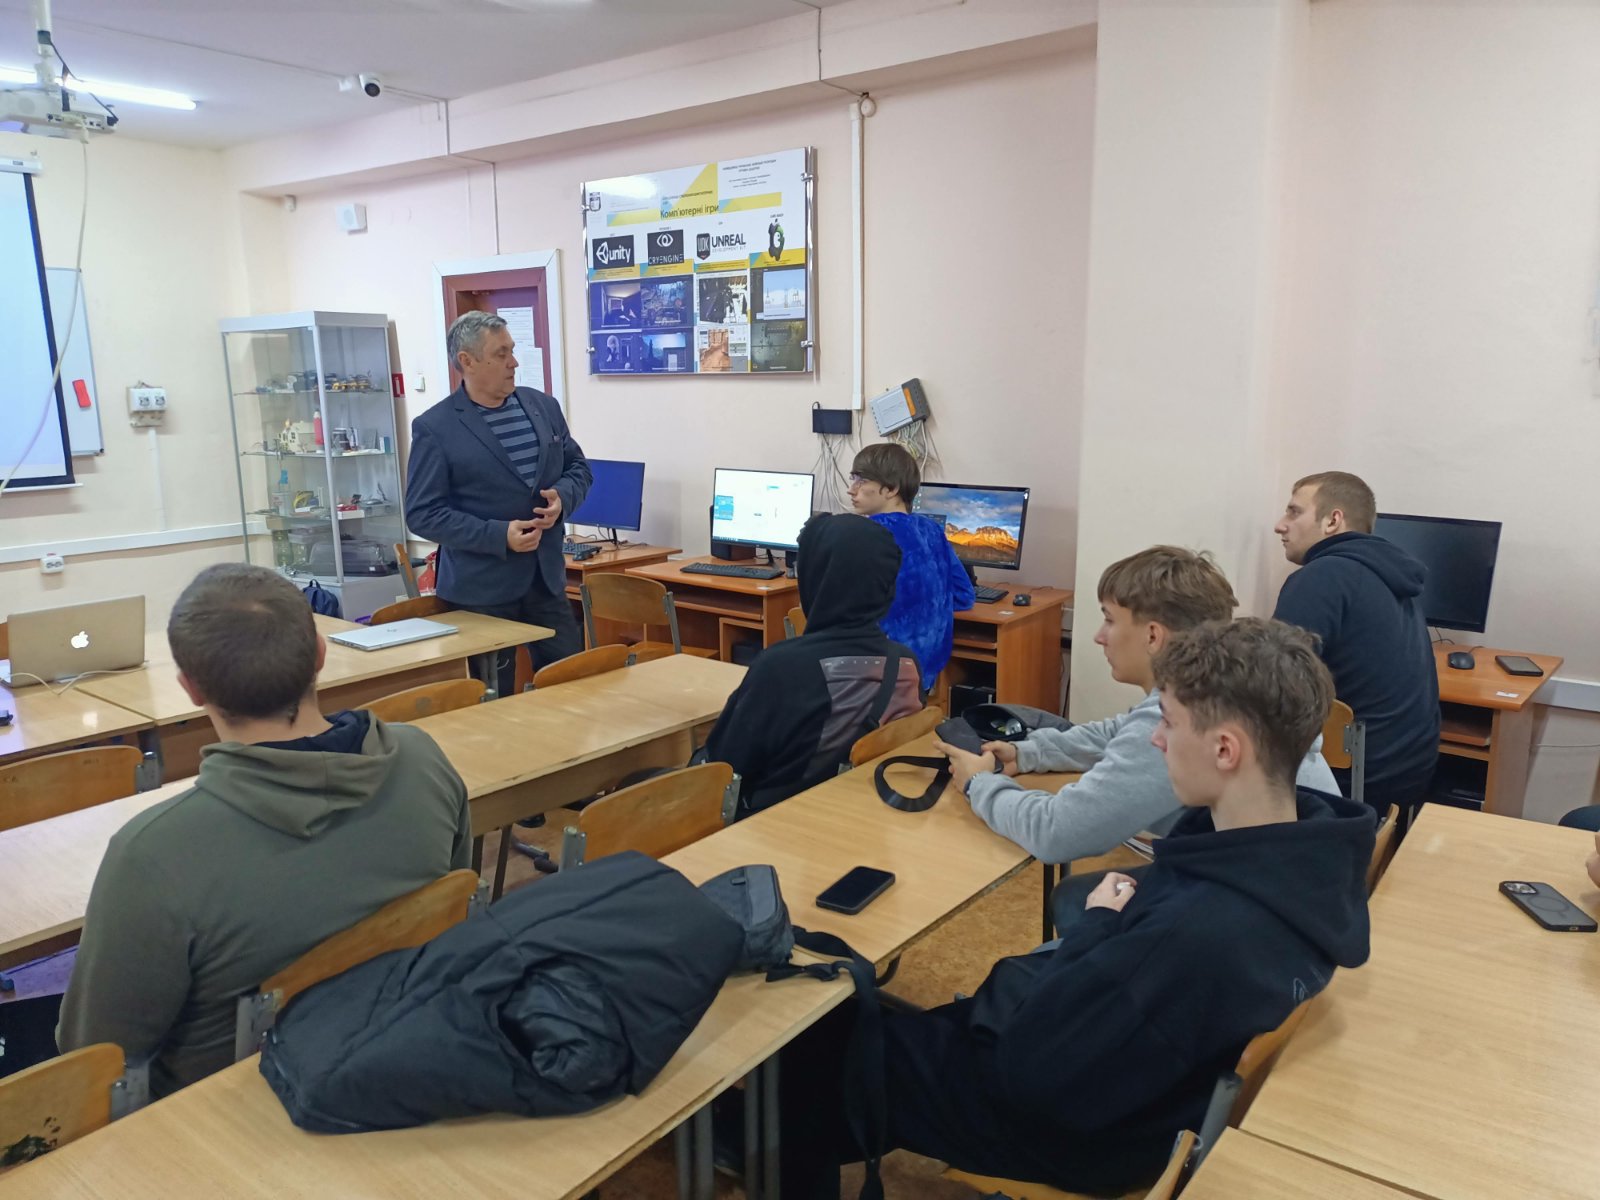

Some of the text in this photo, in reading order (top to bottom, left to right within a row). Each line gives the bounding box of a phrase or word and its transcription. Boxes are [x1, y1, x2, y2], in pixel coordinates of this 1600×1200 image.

[660, 204, 703, 219] Комп'ютерні
[697, 236, 710, 252] UDK
[711, 233, 746, 248] UNREAL
[608, 244, 631, 263] unity
[648, 253, 684, 265] CRYENGINE
